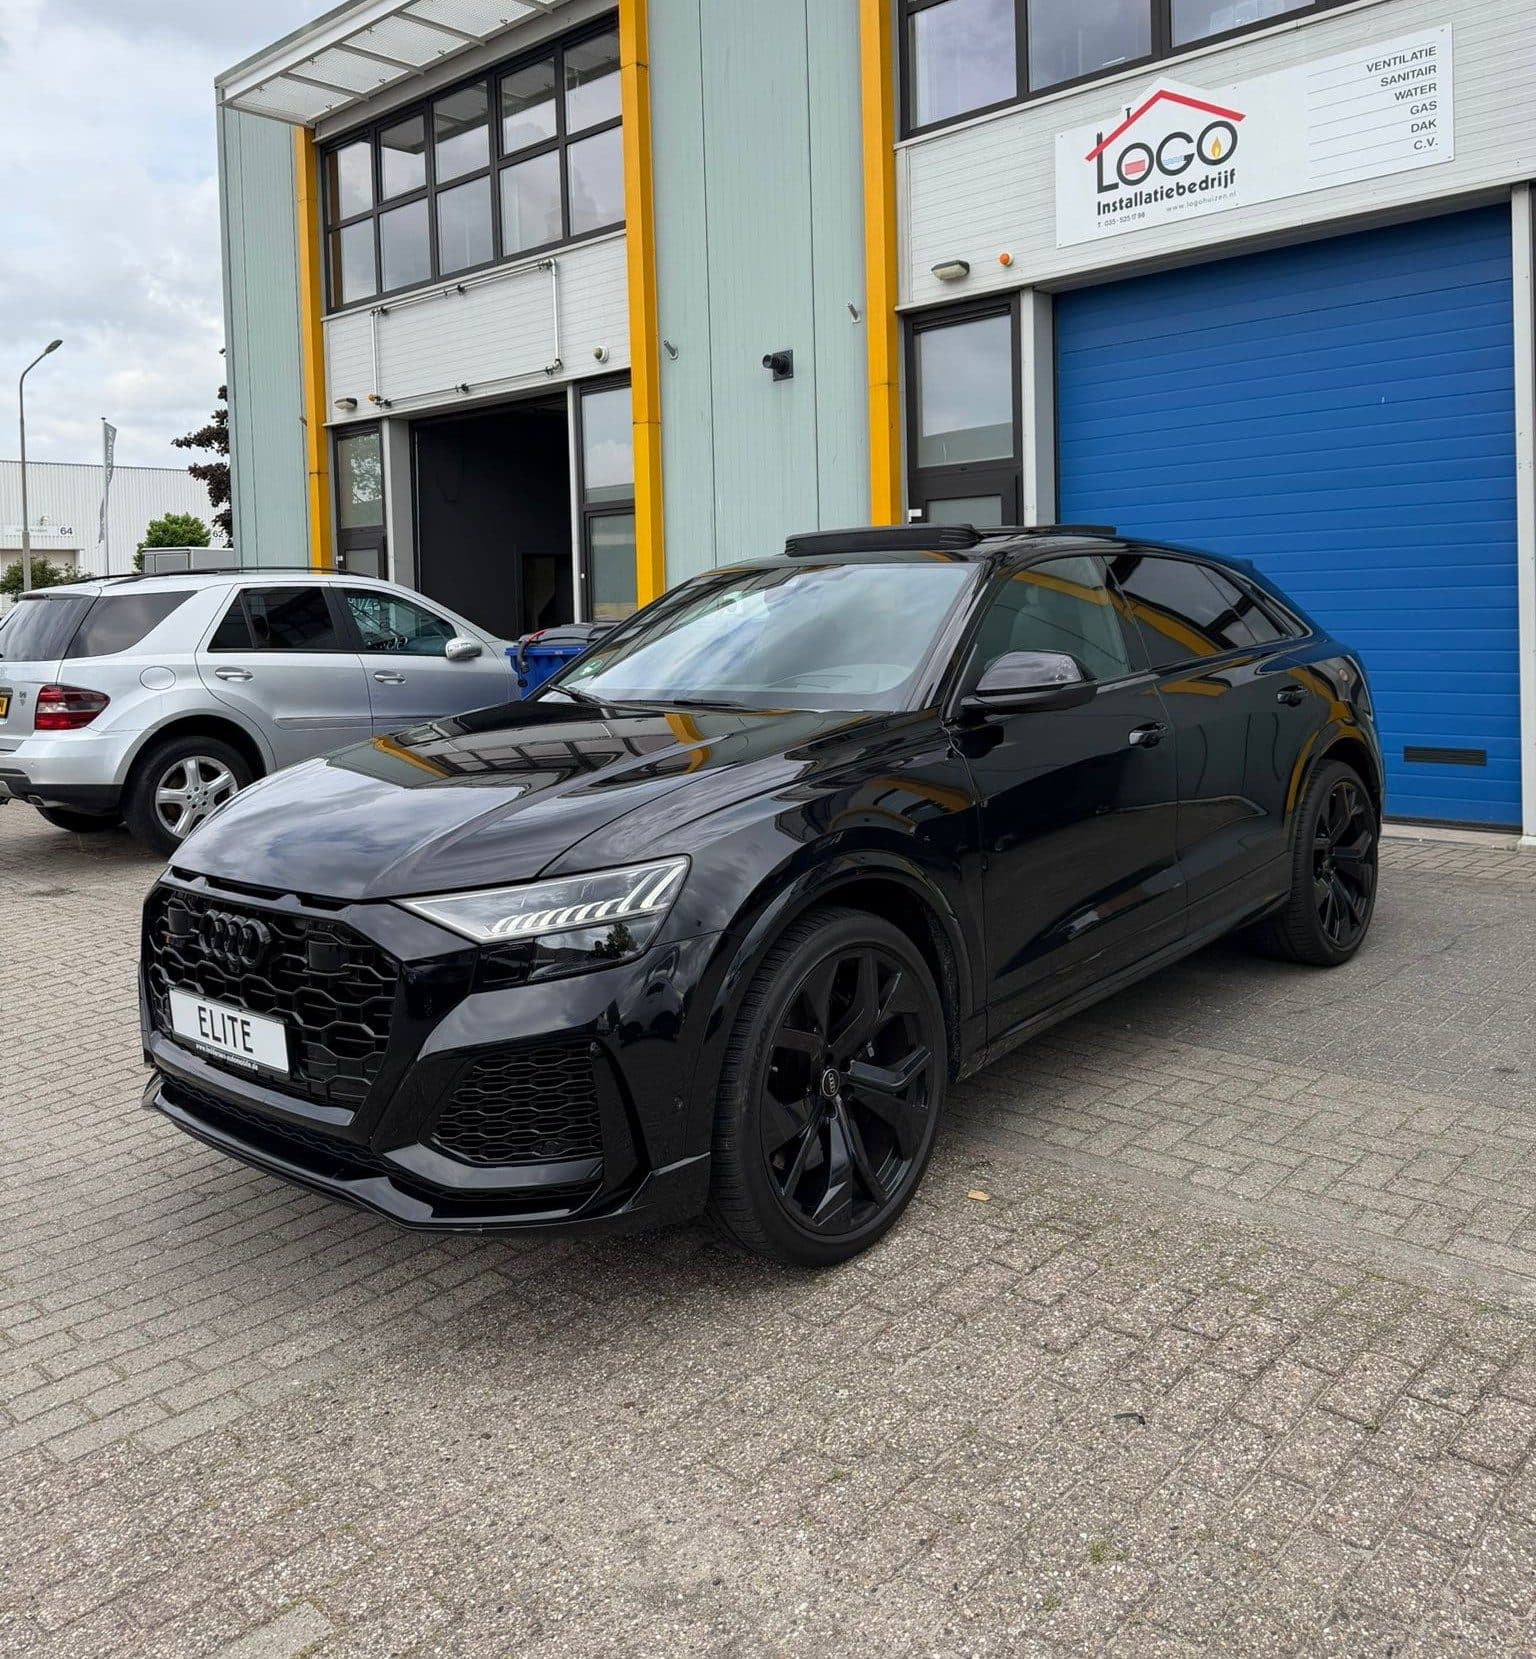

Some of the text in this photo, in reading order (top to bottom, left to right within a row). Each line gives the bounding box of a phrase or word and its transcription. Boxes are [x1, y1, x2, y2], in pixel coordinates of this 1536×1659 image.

[1366, 45, 1437, 73] VENTILATIE
[1380, 64, 1437, 87] SANITAIR
[1394, 82, 1437, 101] WATER
[1410, 100, 1437, 115] GAS
[1410, 118, 1437, 133] DAK
[1413, 137, 1439, 150] C.V.
[1096, 120, 1239, 194] LOGO
[1096, 168, 1236, 216] Installatiebedrijf
[60, 526, 73, 535] 64
[197, 1005, 254, 1054] ELITE
